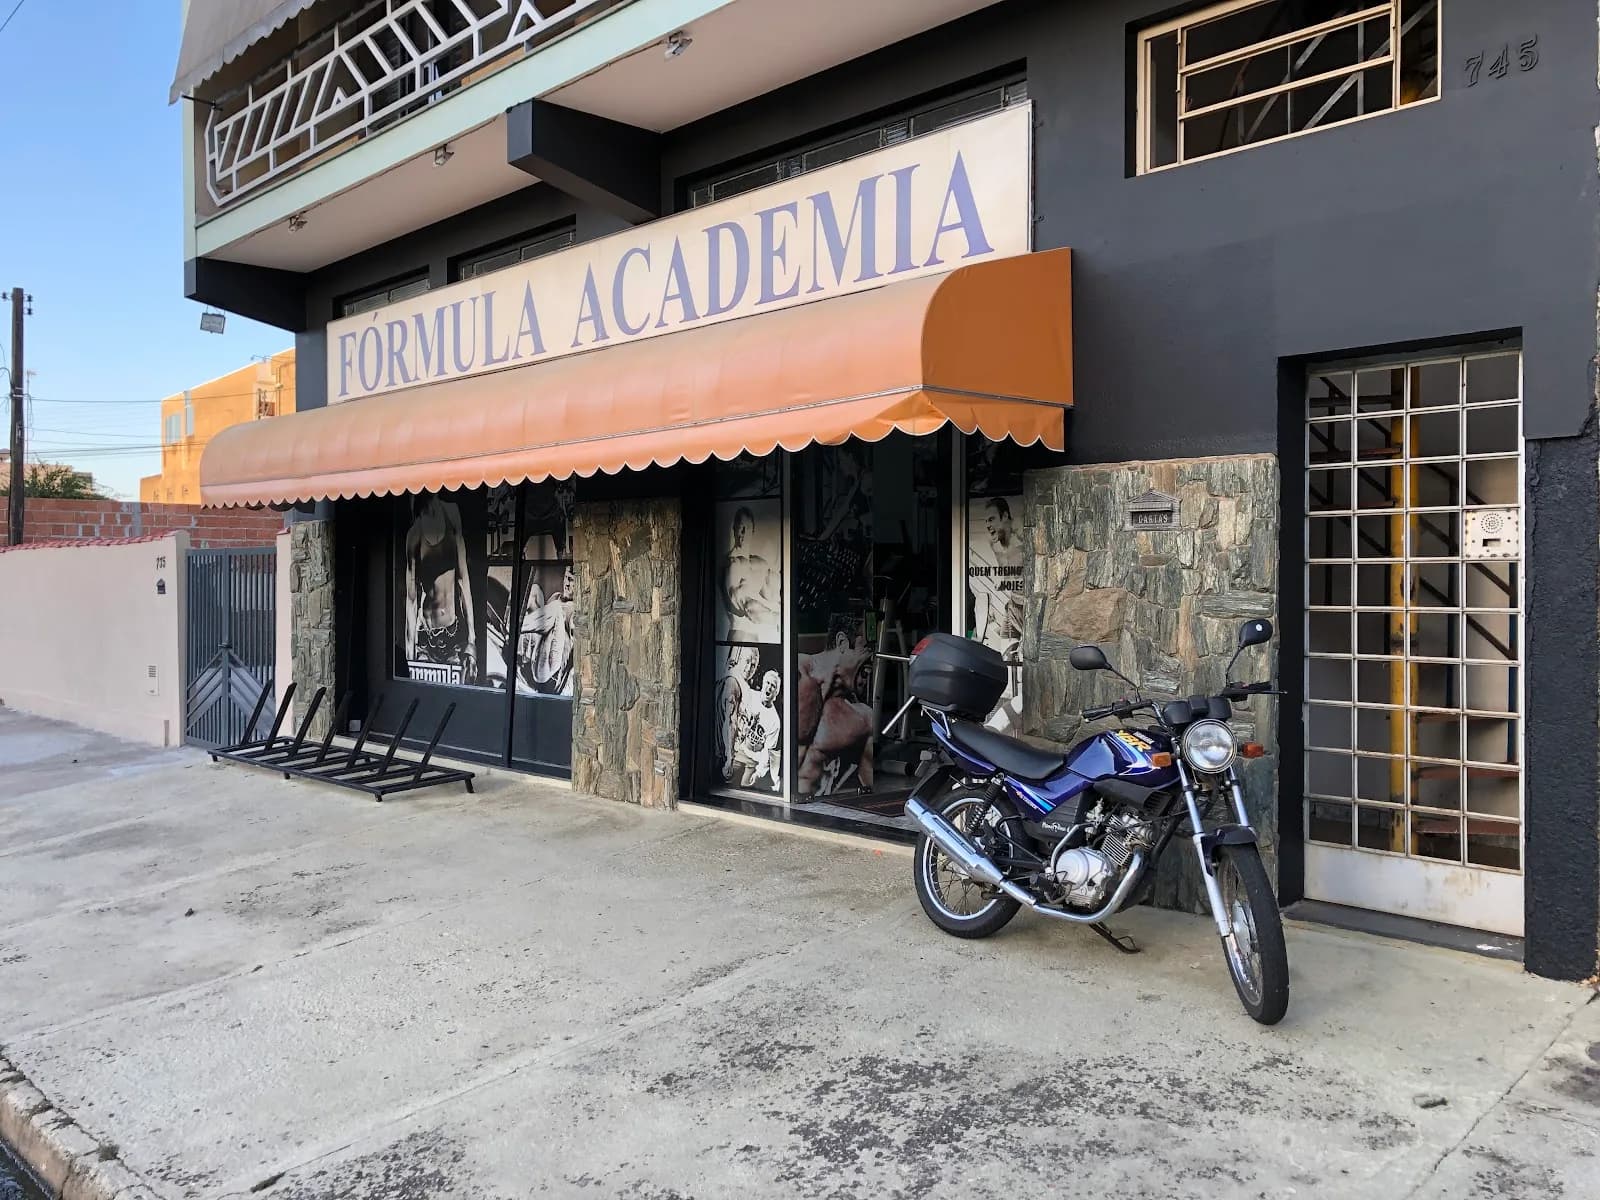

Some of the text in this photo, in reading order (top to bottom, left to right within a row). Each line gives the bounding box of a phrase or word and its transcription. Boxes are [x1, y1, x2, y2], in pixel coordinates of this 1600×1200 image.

[1464, 33, 1540, 88] 745
[337, 151, 994, 398] FÓRMULA ACADEMIA
[969, 566, 991, 577] QUEM
